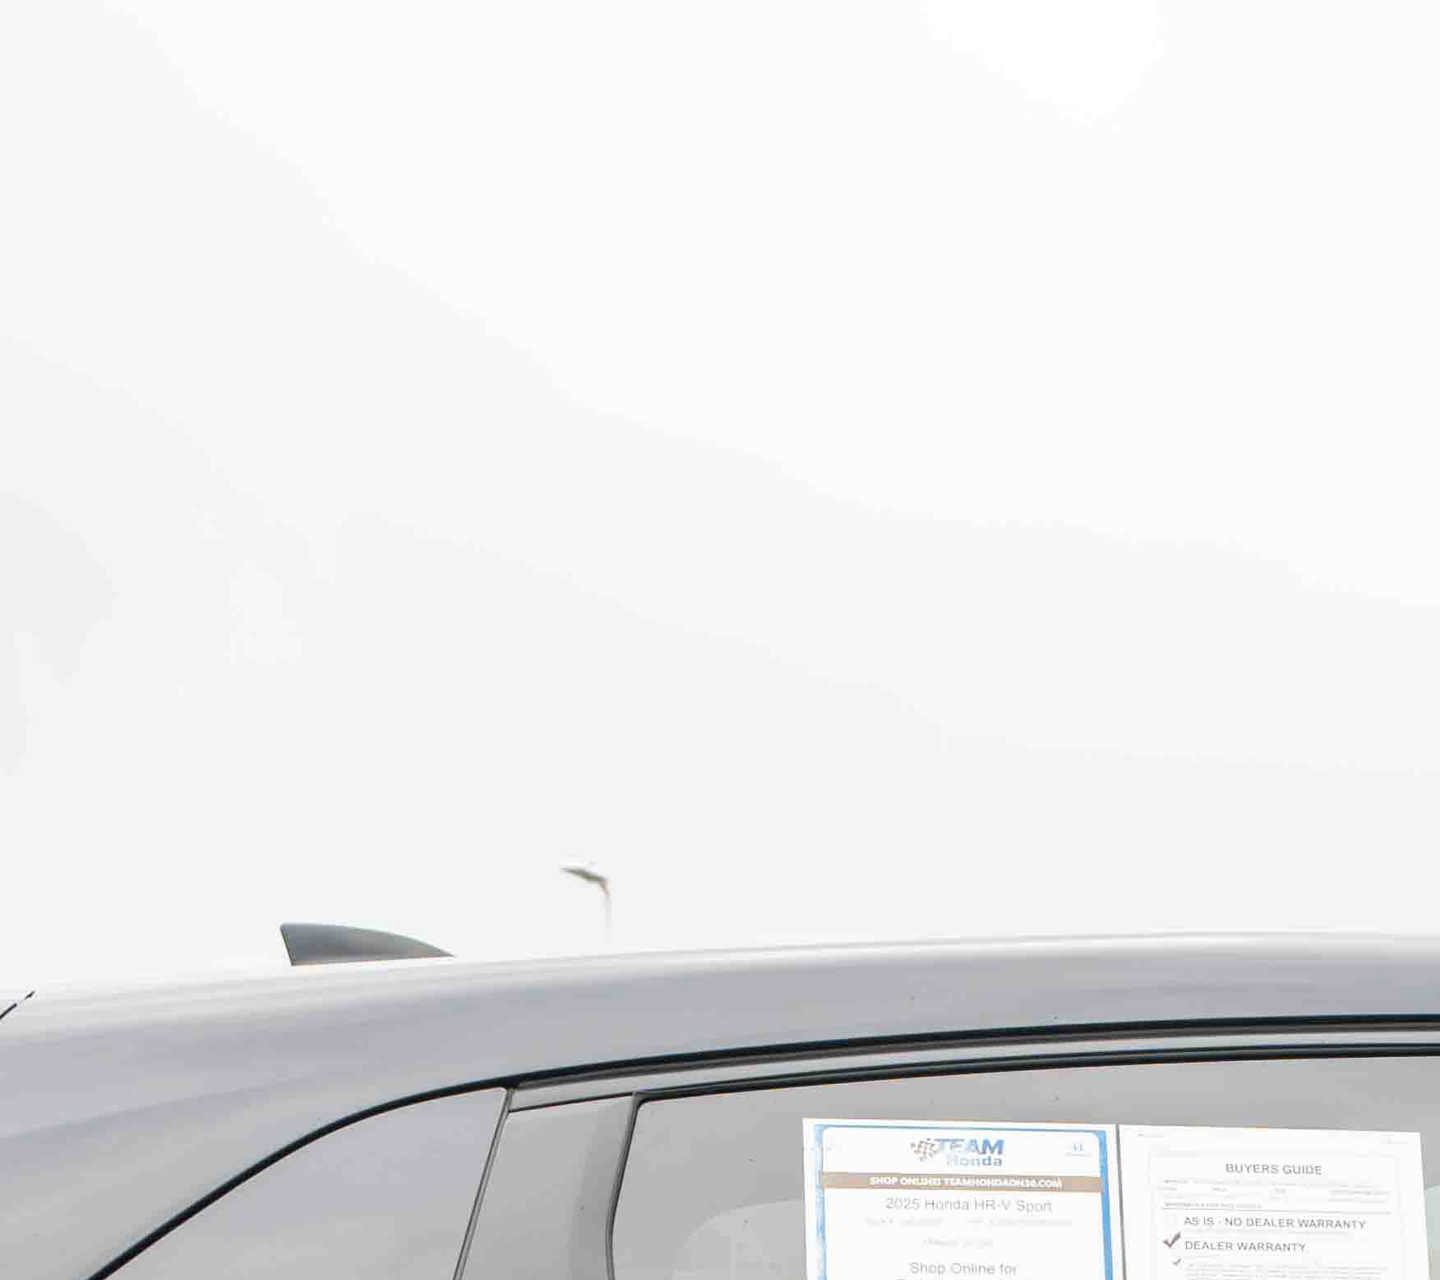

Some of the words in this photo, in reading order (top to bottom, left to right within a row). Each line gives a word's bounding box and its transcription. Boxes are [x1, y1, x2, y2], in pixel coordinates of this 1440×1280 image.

[934, 1138, 1004, 1156] TEAM
[1224, 1162, 1279, 1175] BUYERS
[1282, 1163, 1322, 1176] GUIDE
[869, 1176, 898, 1187] SHOP
[885, 1197, 920, 1210] 2025
[924, 1198, 969, 1211] Honda
[974, 1199, 1010, 1211] HR-V
[1016, 1200, 1053, 1214] Sport
[1184, 1216, 1200, 1226] AS
[1203, 1216, 1215, 1226] IS
[1224, 1217, 1243, 1227] NO
[1246, 1217, 1294, 1229] DEALER
[1297, 1218, 1367, 1230] WARRANTY
[1185, 1240, 1233, 1252] DEALER
[1236, 1241, 1306, 1253] WARRANTY
[910, 1262, 946, 1276] Shop
[949, 1262, 996, 1275] Online
[999, 1262, 1017, 1275] for
